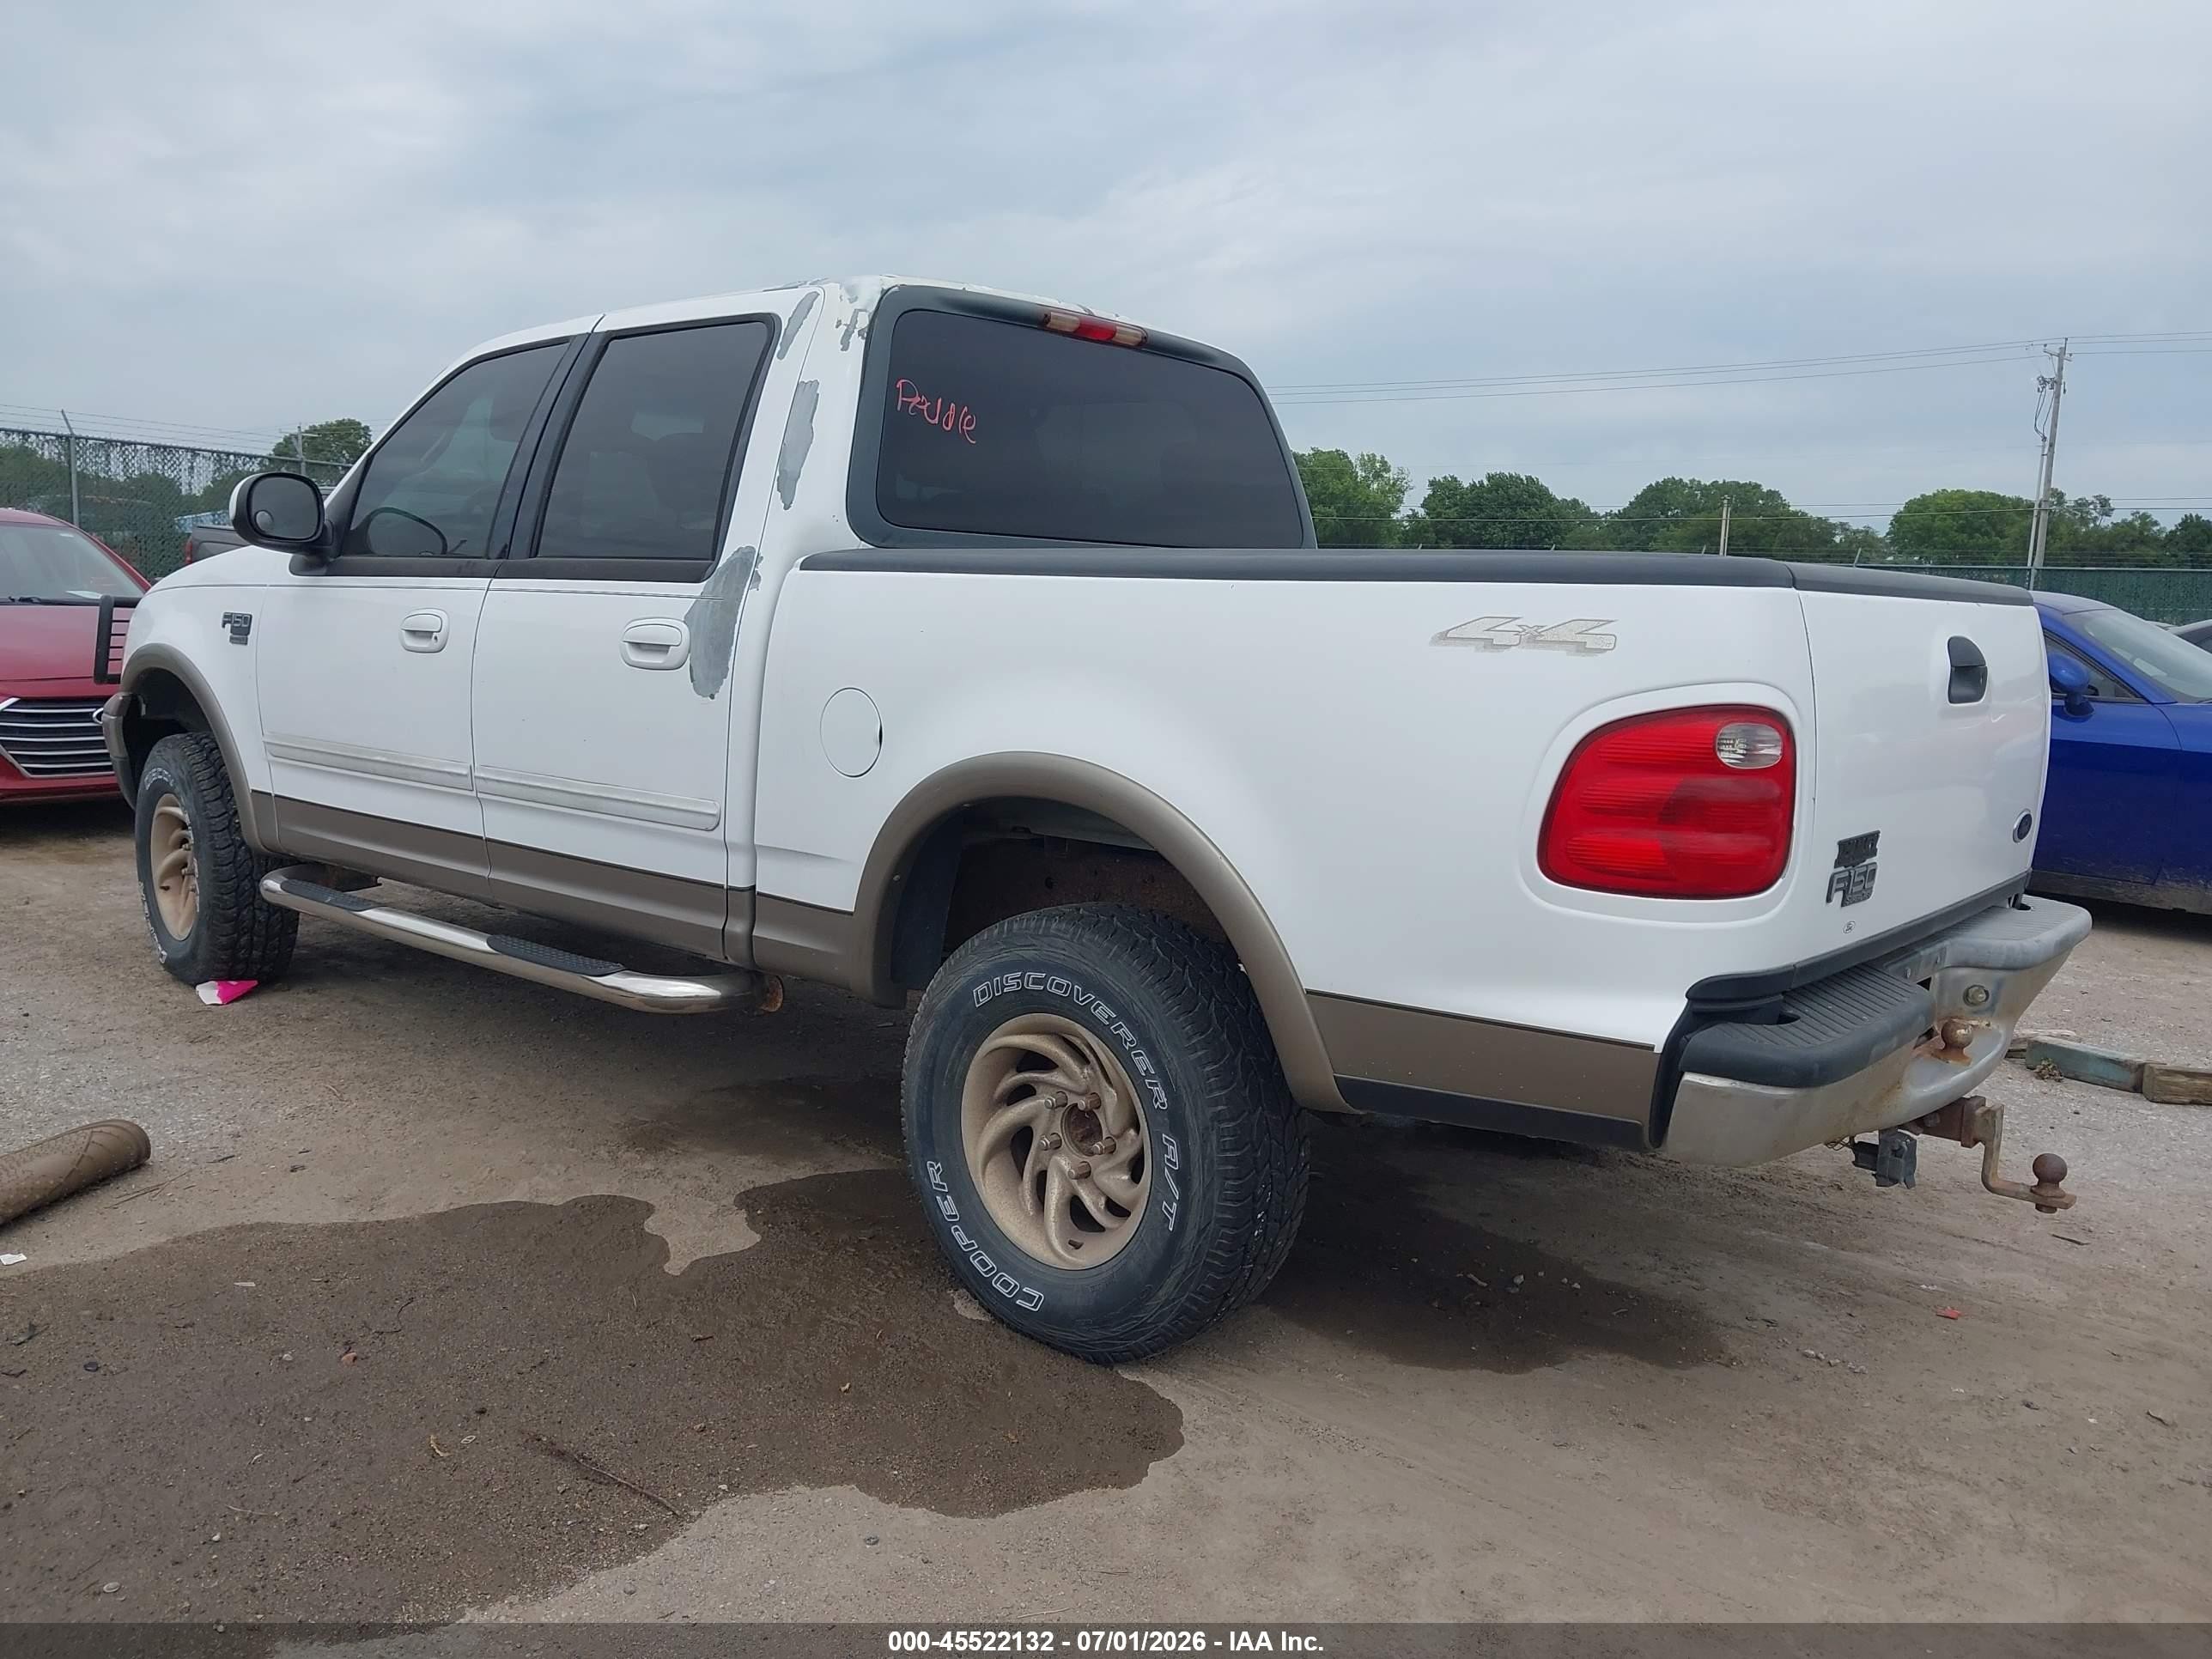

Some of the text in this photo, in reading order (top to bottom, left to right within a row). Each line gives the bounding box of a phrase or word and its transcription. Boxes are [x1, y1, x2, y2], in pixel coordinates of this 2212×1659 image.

[1430, 616, 1617, 657] 4x4
[972, 971, 1182, 1232] DISCOVERER A/T
[924, 1160, 1045, 1313] COOPER
